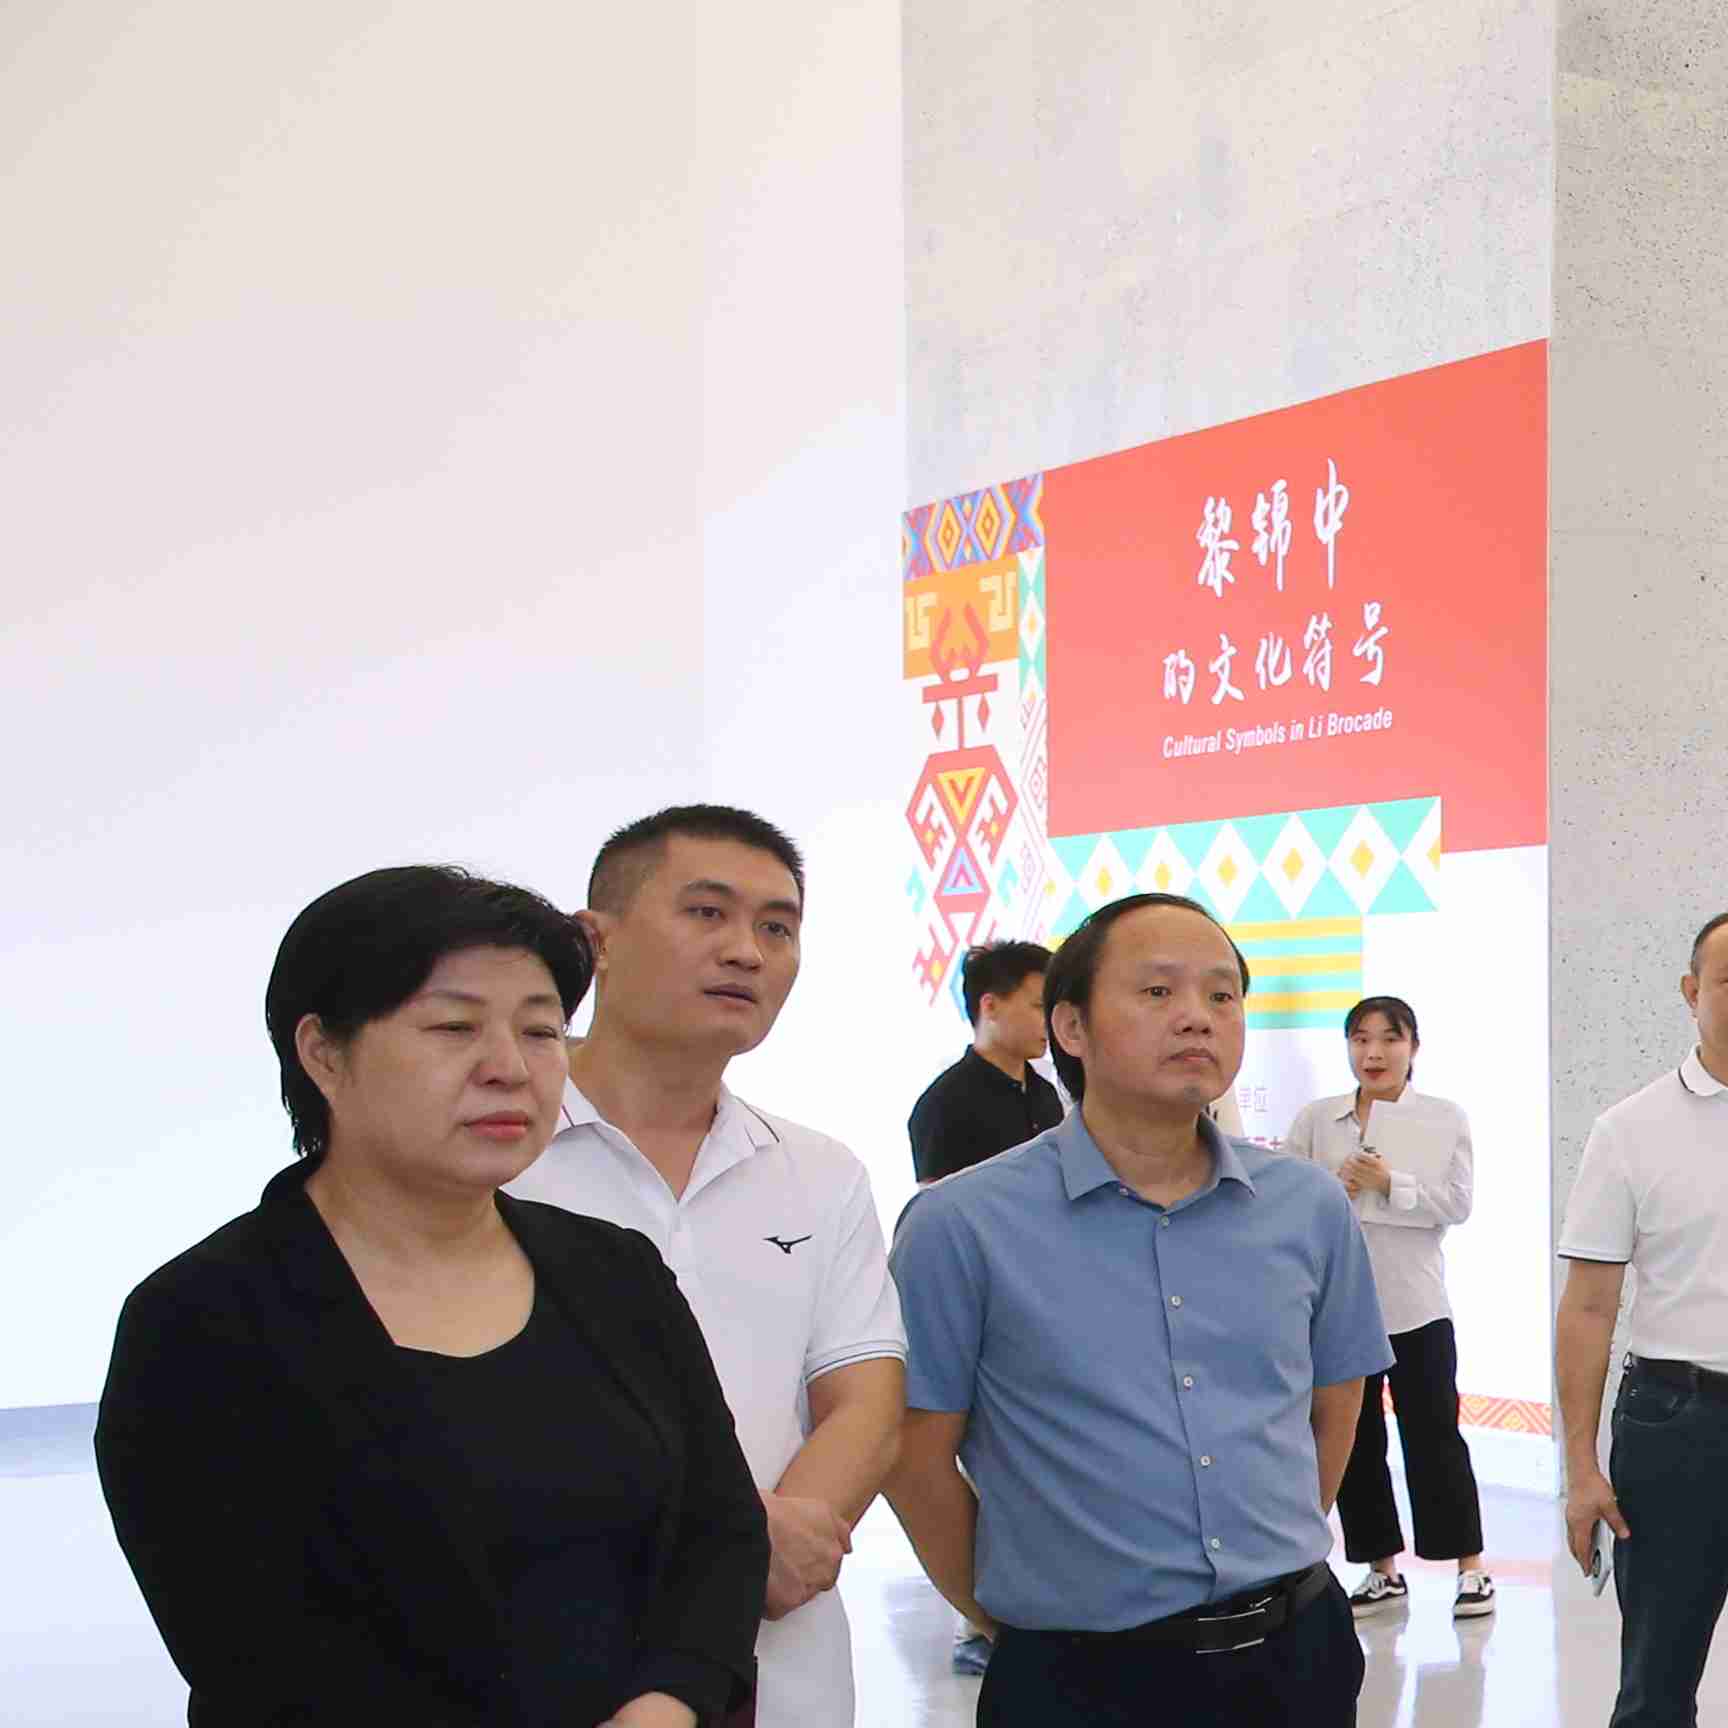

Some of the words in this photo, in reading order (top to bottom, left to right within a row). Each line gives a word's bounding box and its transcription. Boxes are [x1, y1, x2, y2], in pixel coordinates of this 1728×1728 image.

[1196, 456, 1350, 598] 黎锦中
[1161, 601, 1390, 705] 的文化符号
[1162, 730, 1221, 759] Cultural
[1225, 720, 1286, 755] Symbols
[1290, 719, 1304, 743] in
[1308, 715, 1323, 739] Li
[1327, 707, 1393, 737] Brocade
